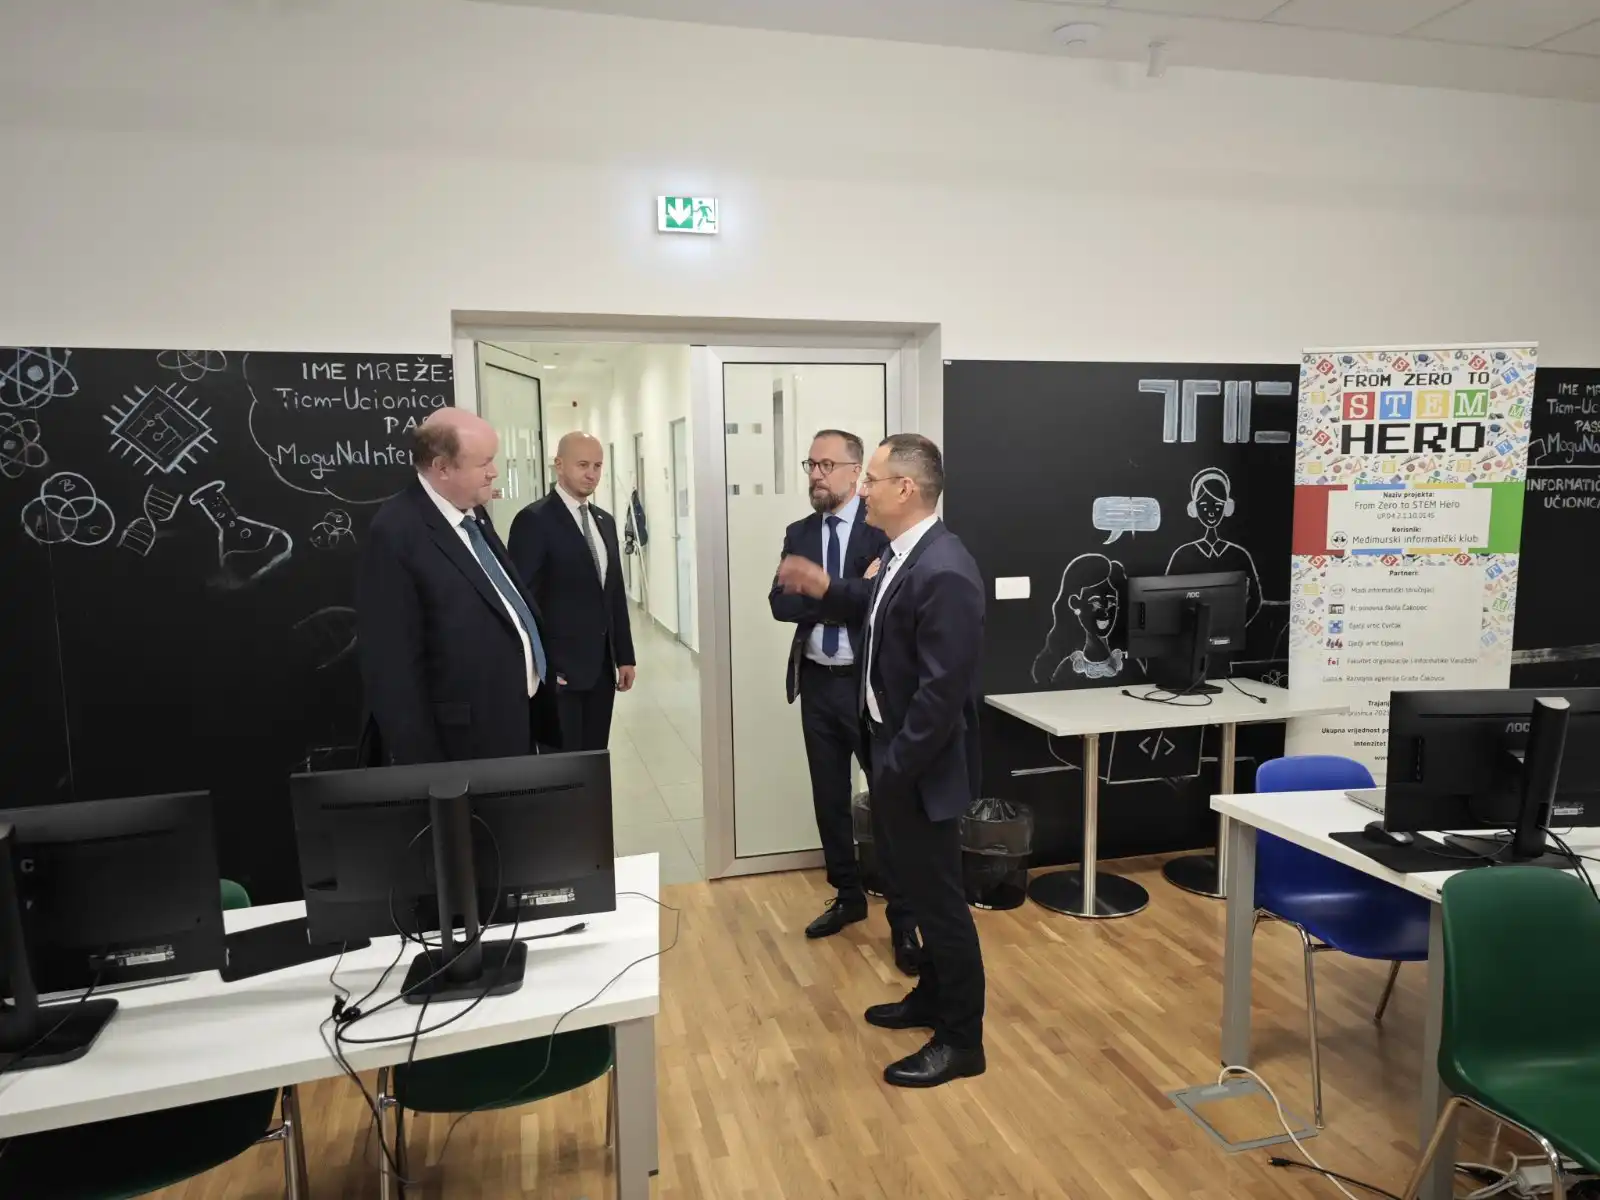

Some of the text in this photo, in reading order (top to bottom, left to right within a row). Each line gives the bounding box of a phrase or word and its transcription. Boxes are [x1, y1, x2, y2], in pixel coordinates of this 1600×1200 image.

[302, 356, 454, 382] IME MREŽE:
[1343, 371, 1490, 388] FROM ZERO TO
[1558, 383, 1579, 395] IME
[273, 387, 447, 411] Ticm-Ucionica
[1345, 391, 1487, 419] STEM
[1341, 422, 1486, 454] HERO
[1383, 491, 1435, 500] Naziv projekta:
[1354, 500, 1460, 510] From Zero to STEM Hero
[1352, 535, 1401, 544] Međimurski
[1404, 534, 1456, 543] informatički
[1459, 533, 1479, 543] klub
[1186, 591, 1200, 599] AOC
[1321, 727, 1346, 735] Ukupna
[1347, 727, 1380, 735] vrijednost
[1505, 722, 1531, 734] AOC
